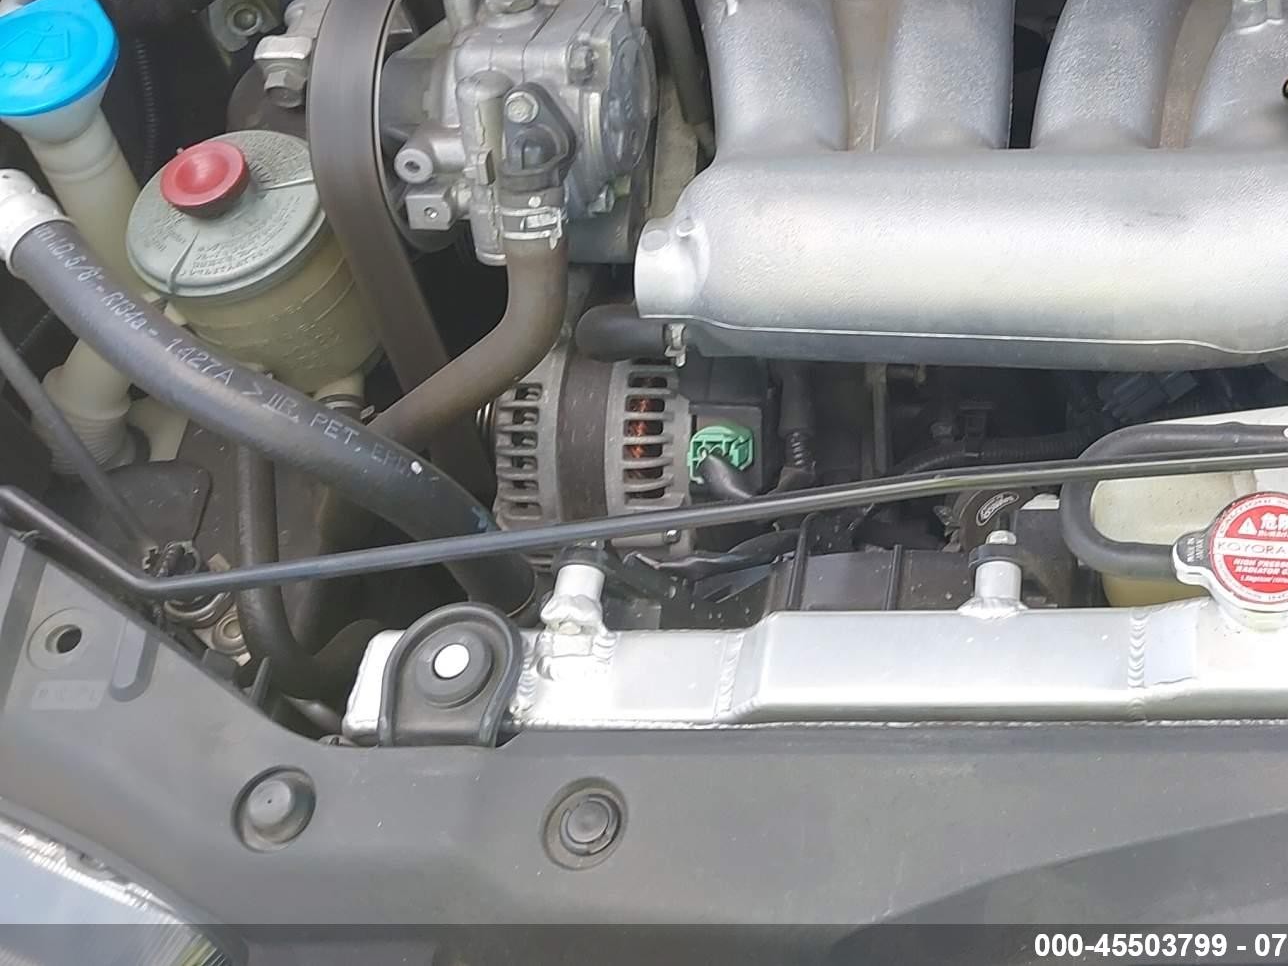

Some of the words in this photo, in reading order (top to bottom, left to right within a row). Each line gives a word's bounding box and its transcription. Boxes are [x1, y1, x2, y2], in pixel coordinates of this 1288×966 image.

[100, 291, 148, 331] R134a
[165, 338, 234, 386] 1427A
[1235, 566, 1280, 575] RADIATOR
